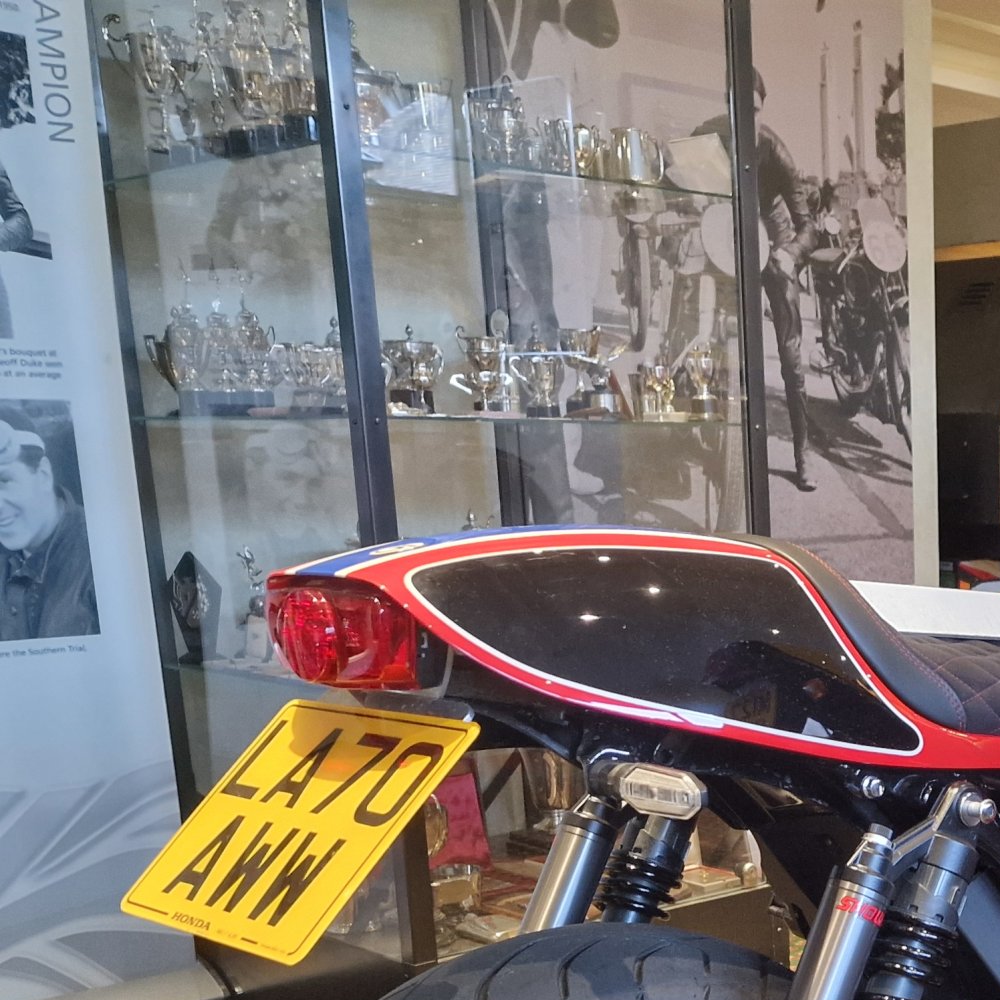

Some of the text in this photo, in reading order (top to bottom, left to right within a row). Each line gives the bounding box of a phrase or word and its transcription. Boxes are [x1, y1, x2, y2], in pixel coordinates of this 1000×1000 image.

[12, 649, 27, 657] the
[28, 646, 66, 655] Southern
[220, 720, 444, 827] LA70
[162, 815, 347, 927] AWW
[171, 911, 211, 931] HONDA
